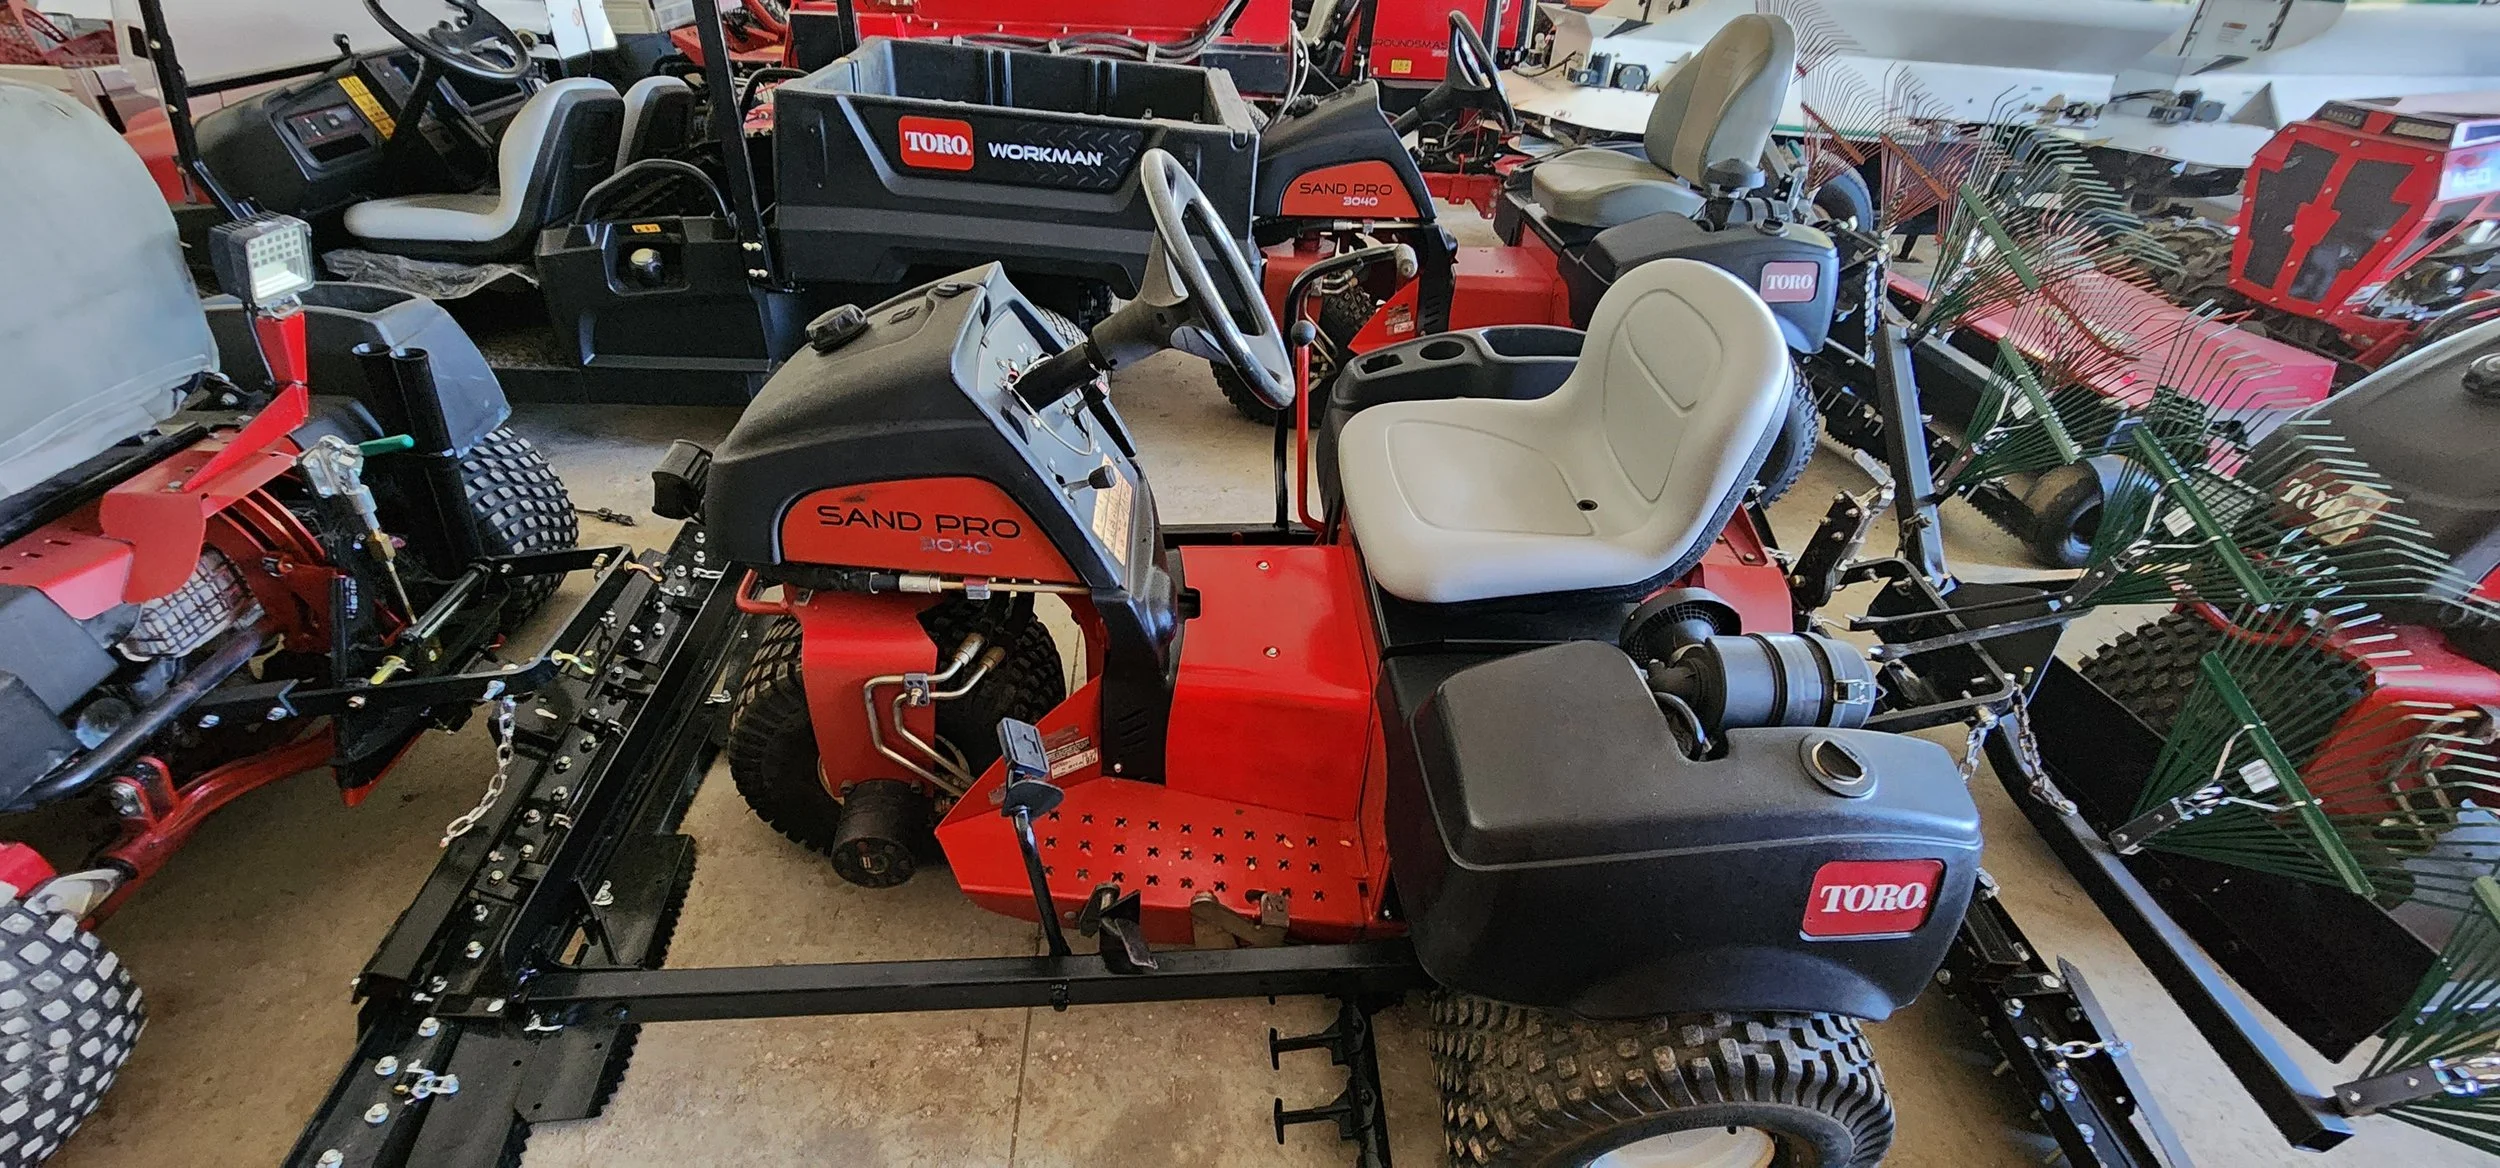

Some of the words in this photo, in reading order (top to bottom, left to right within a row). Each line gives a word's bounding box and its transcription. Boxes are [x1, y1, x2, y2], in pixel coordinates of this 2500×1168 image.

[905, 131, 971, 155] TORO
[988, 142, 1102, 166] WORKMAN
[1300, 183, 1347, 195] SAND
[1353, 184, 1392, 196] PRO
[1343, 196, 1378, 206] 3040
[1766, 274, 1813, 290] TORO
[816, 505, 922, 532] SAND
[935, 514, 1021, 539] PRO
[920, 536, 992, 555] 3040
[1820, 882, 1926, 913] TORO
